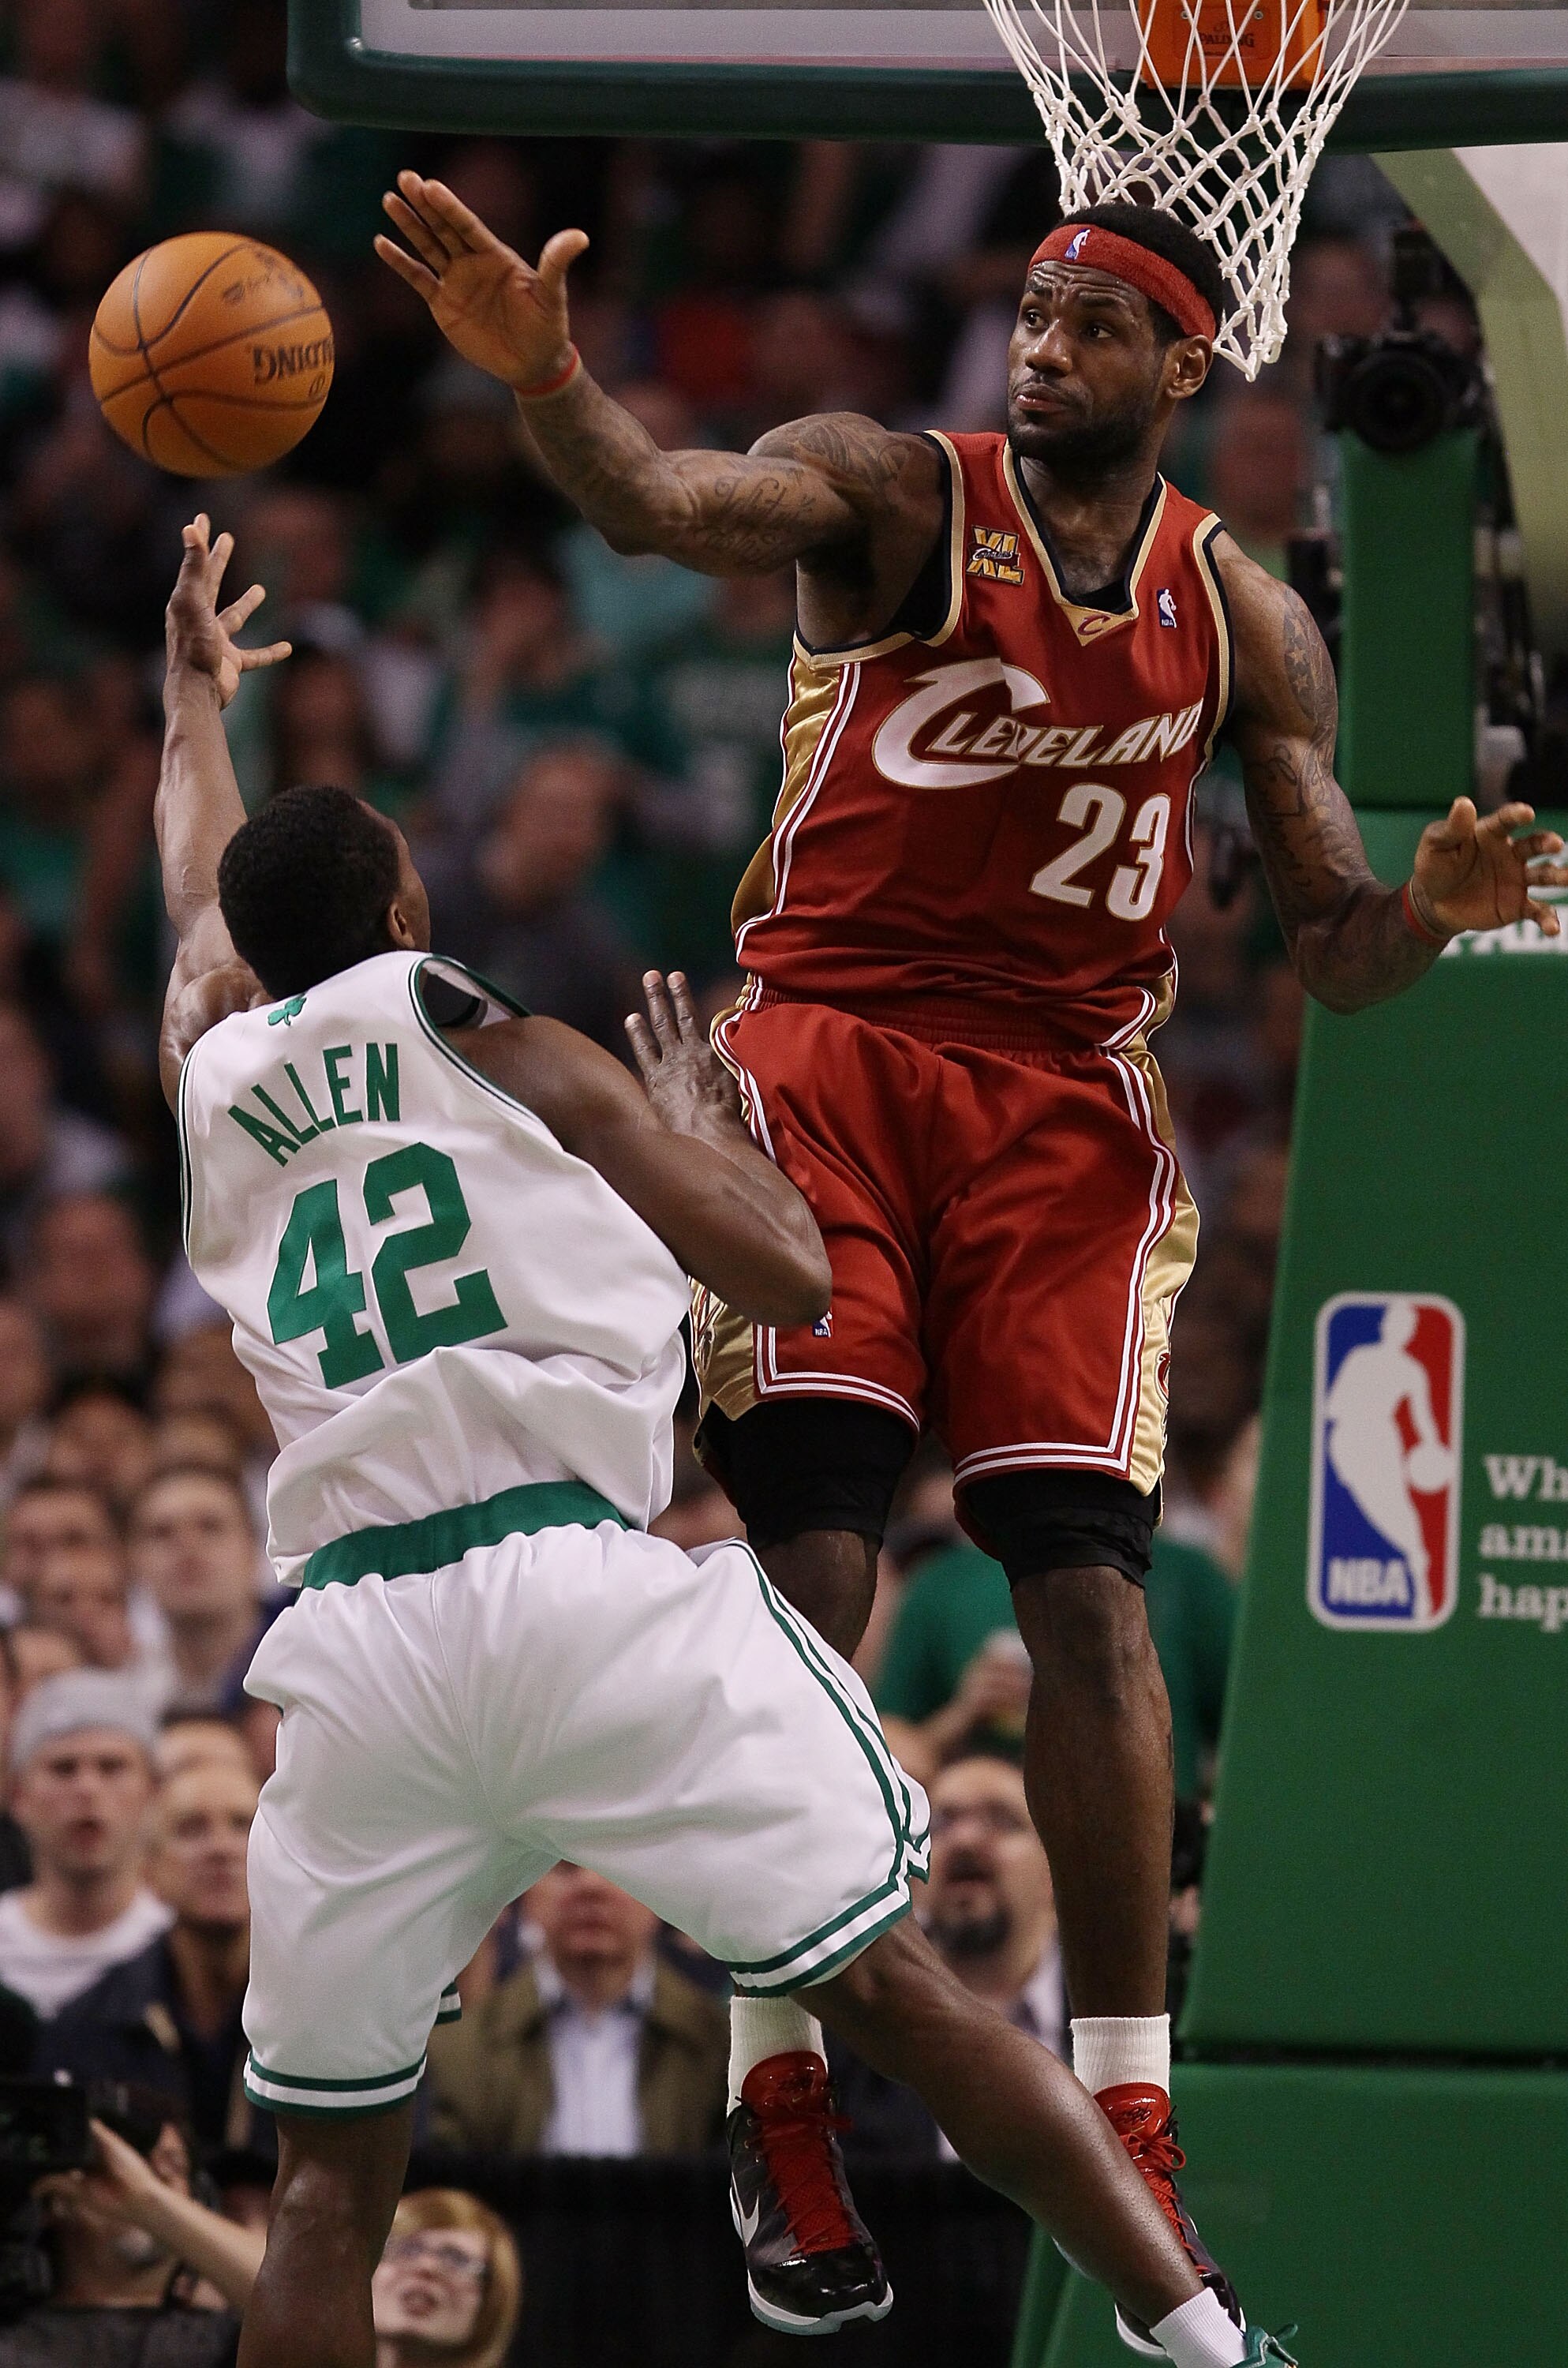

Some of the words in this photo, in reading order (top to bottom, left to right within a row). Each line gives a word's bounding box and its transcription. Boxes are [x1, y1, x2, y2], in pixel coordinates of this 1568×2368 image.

[871, 658, 1204, 789] CLEVELAND
[1028, 782, 1171, 922] 23
[228, 1043, 400, 1167] ALLEN
[267, 1142, 508, 1389] 42
[1329, 1557, 1409, 1605] NBA
[1478, 1523, 1568, 1561] am
